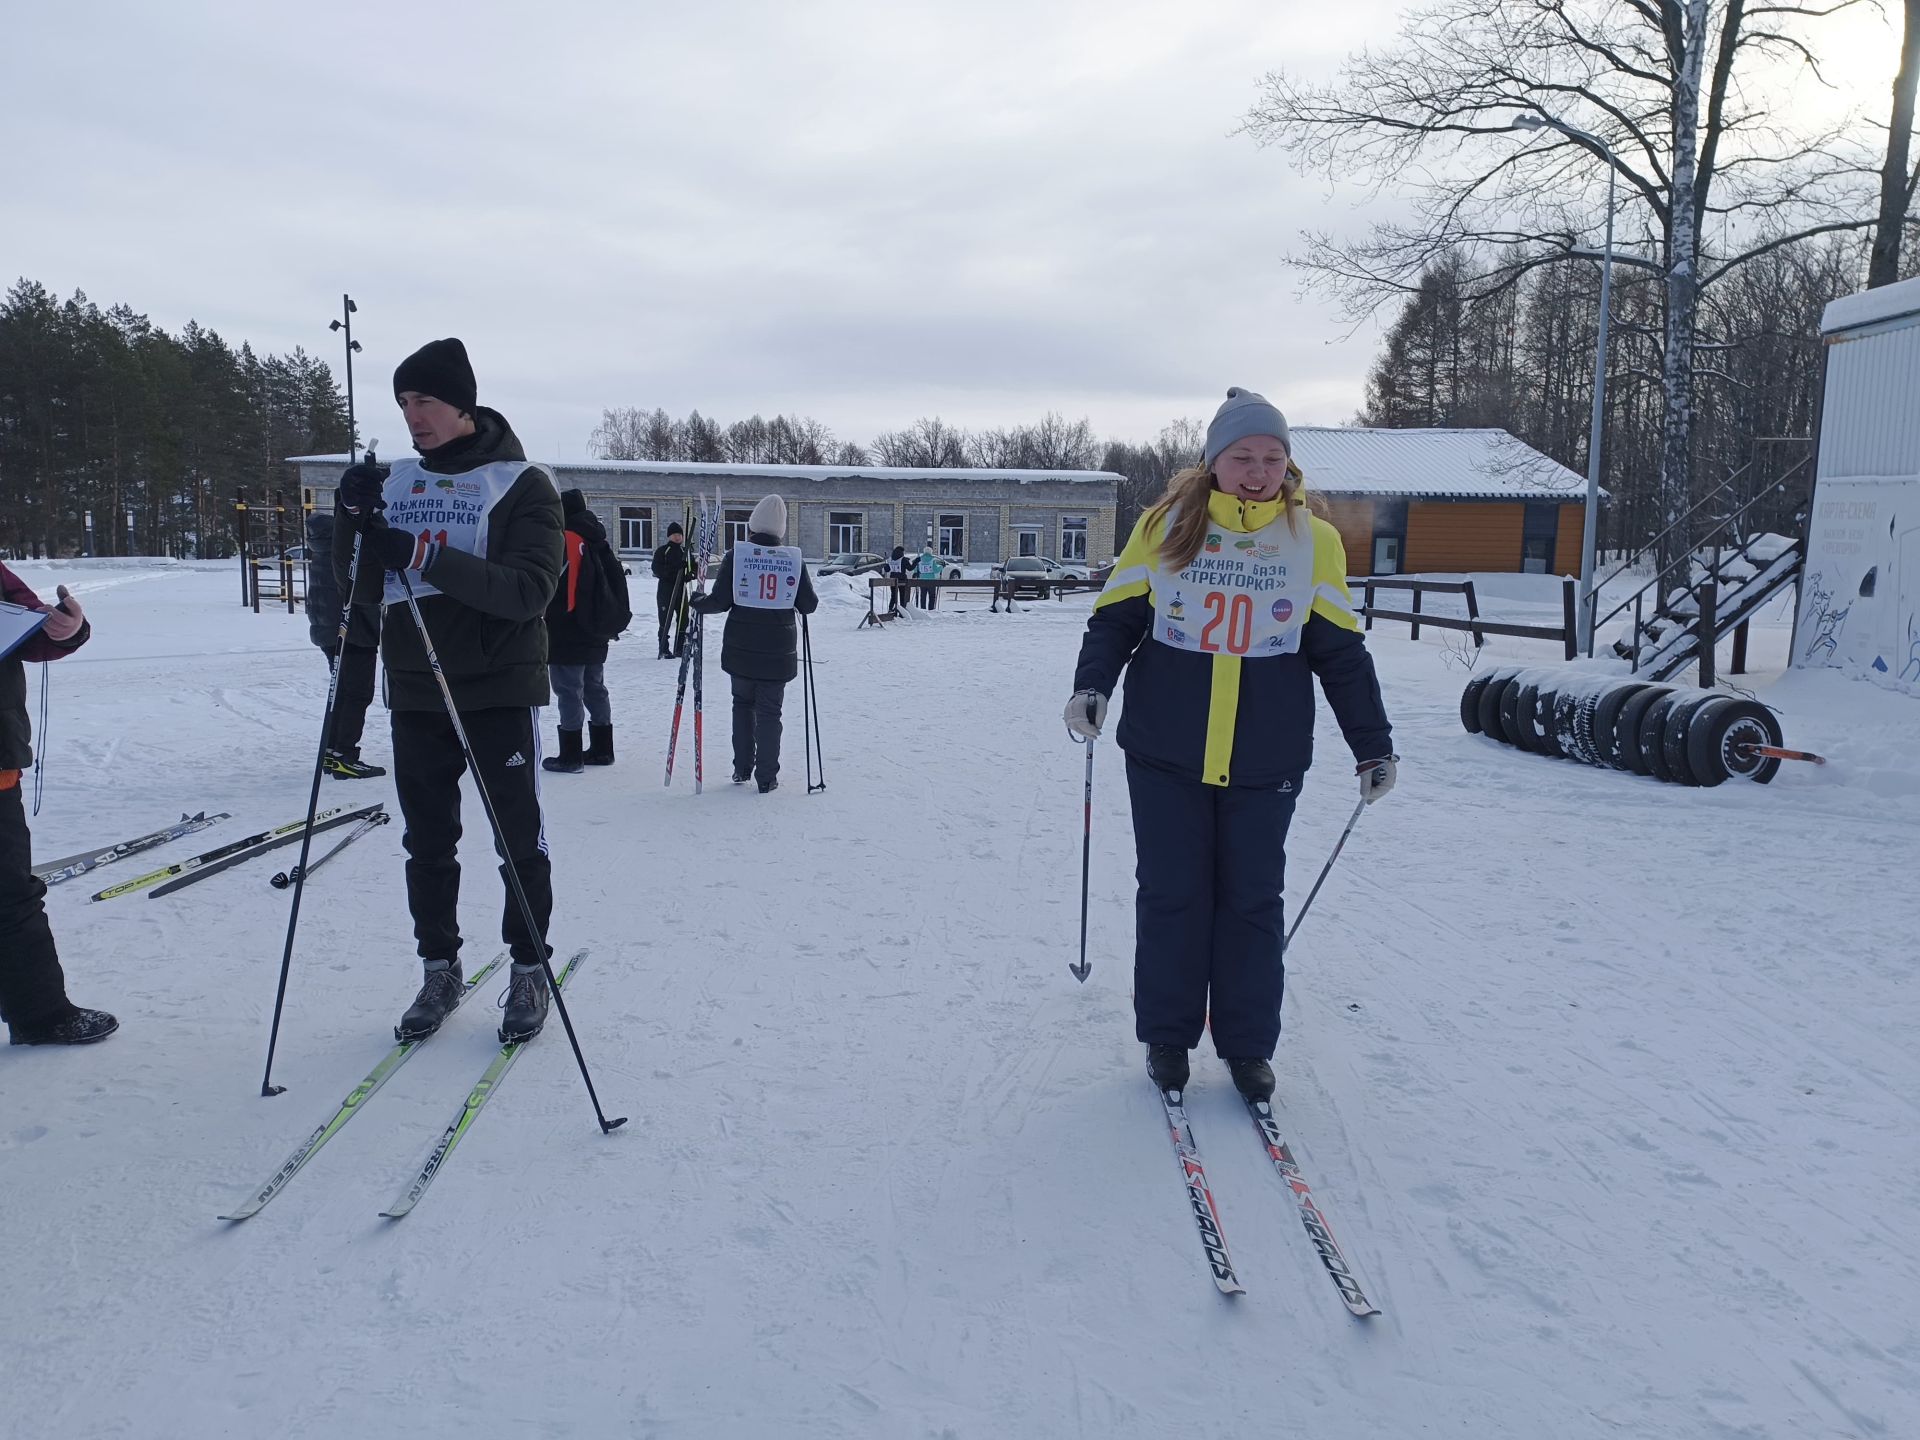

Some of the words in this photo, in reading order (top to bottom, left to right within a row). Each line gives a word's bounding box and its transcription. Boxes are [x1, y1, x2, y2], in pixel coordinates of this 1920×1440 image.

[391, 499, 443, 512] ЛЫЖНАЯ
[453, 500, 483, 512] БАЗА
[744, 564, 792, 572] «ТРЕХГОРКА»
[1187, 557, 1244, 571] ЫЖНАЯ
[1253, 563, 1287, 576] БАЗА
[758, 573, 777, 600] 19
[1180, 570, 1286, 591] «ТРЕХГОРКА»
[1200, 591, 1253, 654] 20
[505, 758, 526, 767] adidas
[106, 882, 134, 896] TOP
[408, 1126, 456, 1202] LARSEN
